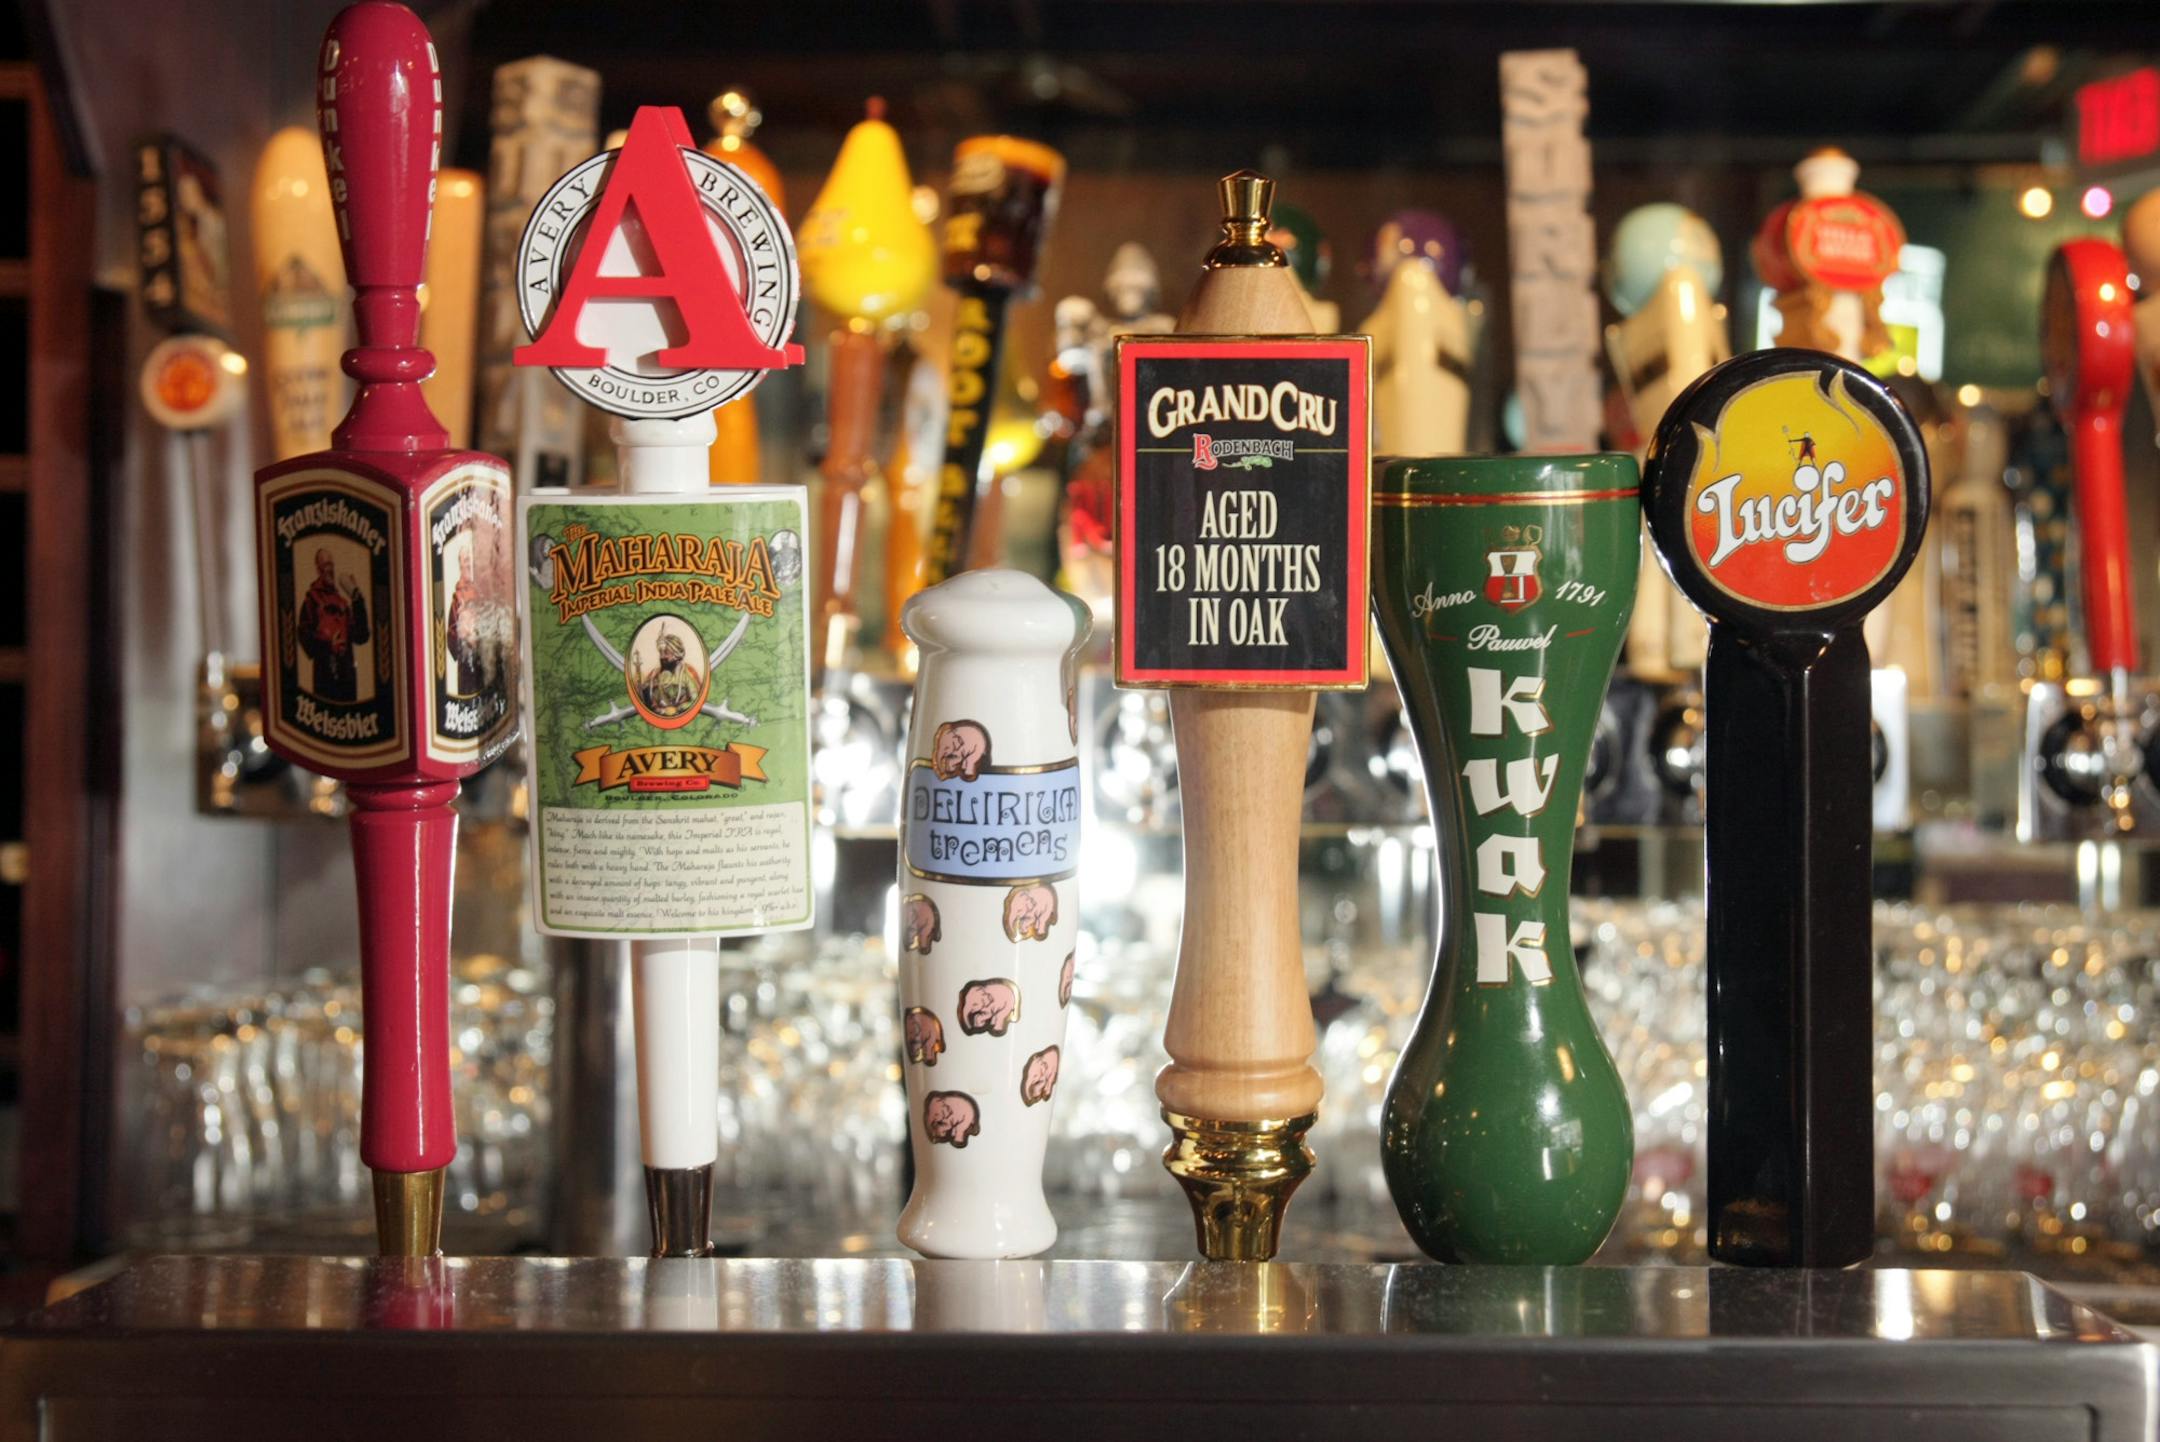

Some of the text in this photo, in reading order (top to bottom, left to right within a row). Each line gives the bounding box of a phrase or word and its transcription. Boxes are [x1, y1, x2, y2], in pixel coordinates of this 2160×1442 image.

[323, 38, 351, 241] Dunkel
[529, 177, 592, 295] AVERY
[699, 171, 777, 329] BREWING
[693, 375, 721, 396] CO
[1148, 381, 1338, 438] GRAND CRU
[1192, 433, 1294, 471] RODENBACH
[1199, 490, 1278, 539] AGED
[1697, 461, 1894, 568] Lucifer
[549, 531, 782, 604] MAHARAJA
[1155, 544, 1321, 593] 18 MONTHS
[560, 578, 775, 624] IMPERIAL INDIA PALE ALE
[1188, 597, 1290, 645] IN OAK
[1411, 579, 1607, 618] Anno 1791
[1467, 623, 1558, 652] Pauwel
[618, 750, 720, 780] AVERY
[671, 791, 739, 801] COLORADO
[912, 785, 1078, 826] DELIRIUM
[929, 828, 1068, 867] tremens
